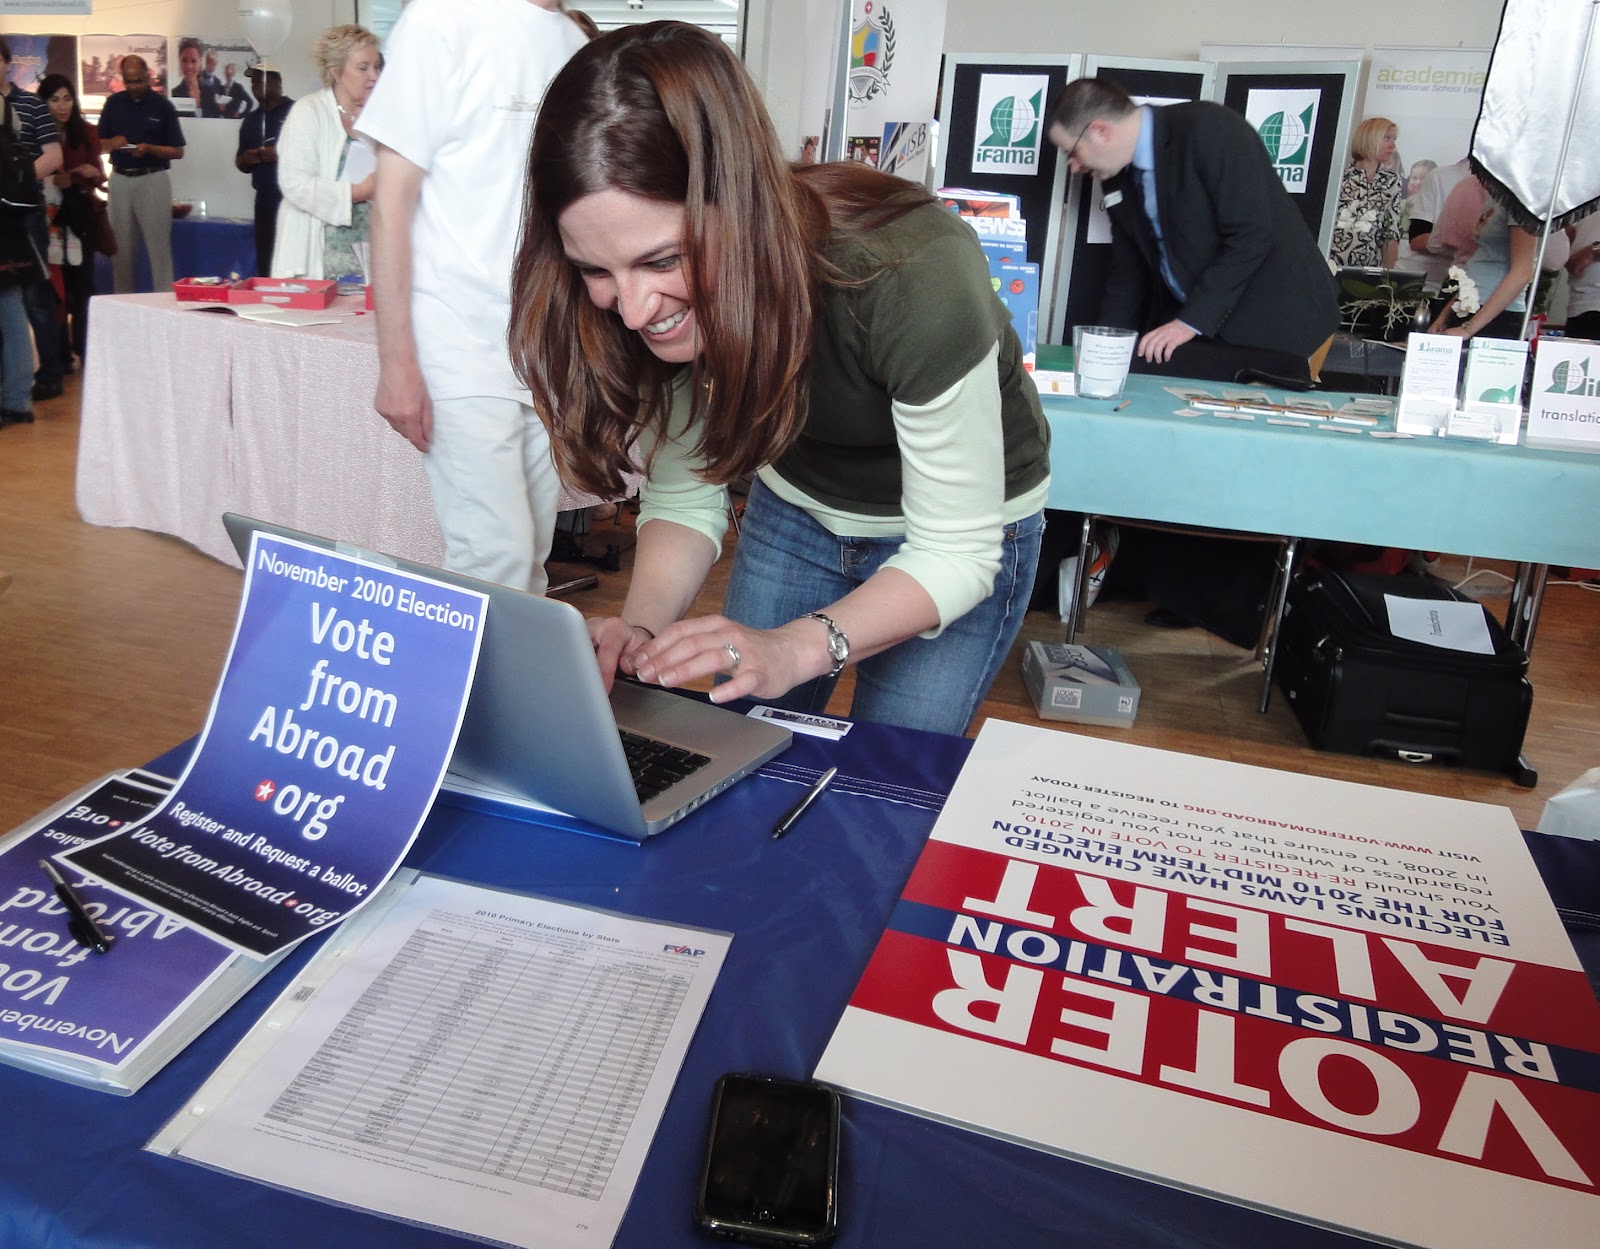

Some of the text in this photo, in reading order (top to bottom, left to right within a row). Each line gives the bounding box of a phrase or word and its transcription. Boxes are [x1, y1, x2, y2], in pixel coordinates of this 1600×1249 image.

[1376, 65, 1485, 86] academia
[258, 550, 475, 632] November 2010 Election
[310, 602, 396, 666] Vote
[300, 659, 398, 728] from
[249, 705, 397, 790] Abroad
[1020, 788, 1083, 808] ballot.
[1030, 775, 1481, 864] VISIT WWW.VOTEFROMABROAD.ORG TO REGISTER TODAY
[1107, 805, 1179, 825] receive
[1186, 821, 1225, 834] you
[169, 801, 369, 898] Register and Request a ballot
[1011, 799, 1493, 897] regardless of whether or not you registered
[1022, 811, 1500, 914] You should RE-REGISTER TO VOTE IN 2010,
[1231, 829, 1276, 845] that
[1284, 840, 1357, 859] ensure
[1365, 855, 1387, 866] to
[1397, 860, 1458, 879] 2008,
[992, 819, 1504, 932] FOR THE 2010 MID-TERM ELECTION
[1004, 836, 1512, 948] ELECTIONS LAWS HAVE CHANGED
[1466, 872, 1488, 885] in
[475, 909, 621, 944] 2010 Primary Elections by State
[961, 857, 1523, 1026] ALERT
[946, 912, 1562, 1084] REGISTRATION
[931, 947, 1596, 1188] VOTER
